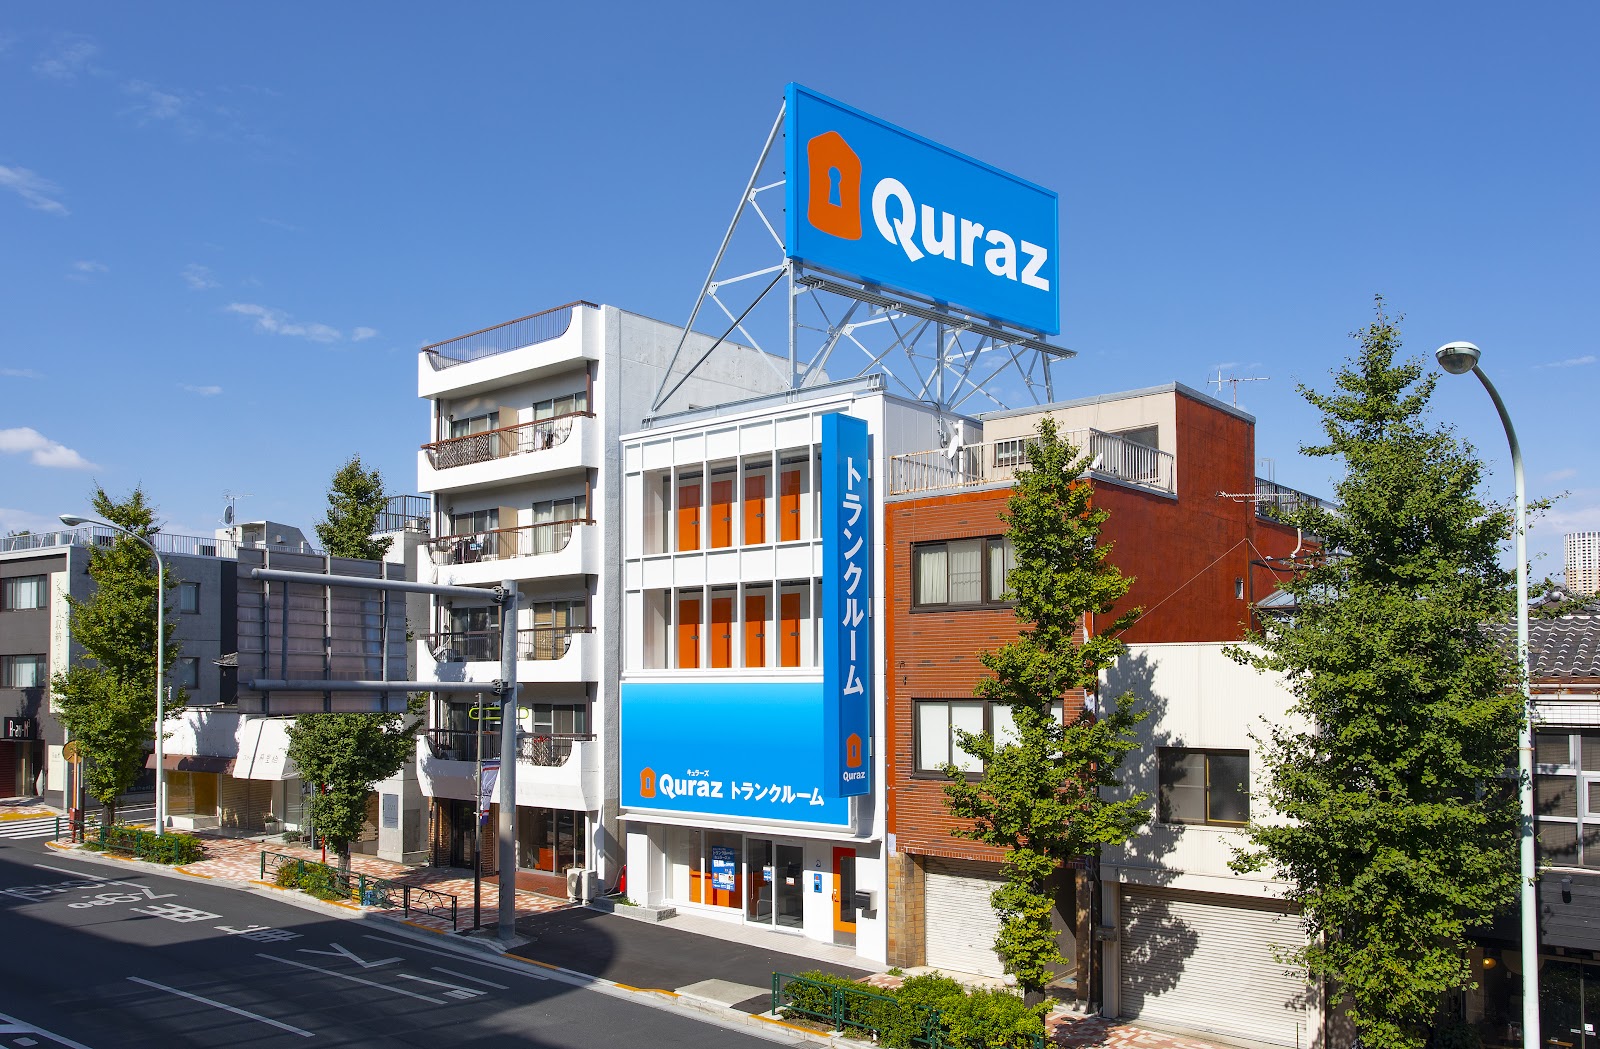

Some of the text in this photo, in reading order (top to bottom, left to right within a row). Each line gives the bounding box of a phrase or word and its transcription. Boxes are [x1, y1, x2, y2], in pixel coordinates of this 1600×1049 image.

[871, 177, 1050, 292] Quraz
[842, 456, 865, 697] トランクルーム
[659, 773, 723, 799] Quraz
[686, 769, 710, 777] キュラーズ
[843, 771, 866, 782] Quraz
[731, 781, 825, 807] トランクルーム
